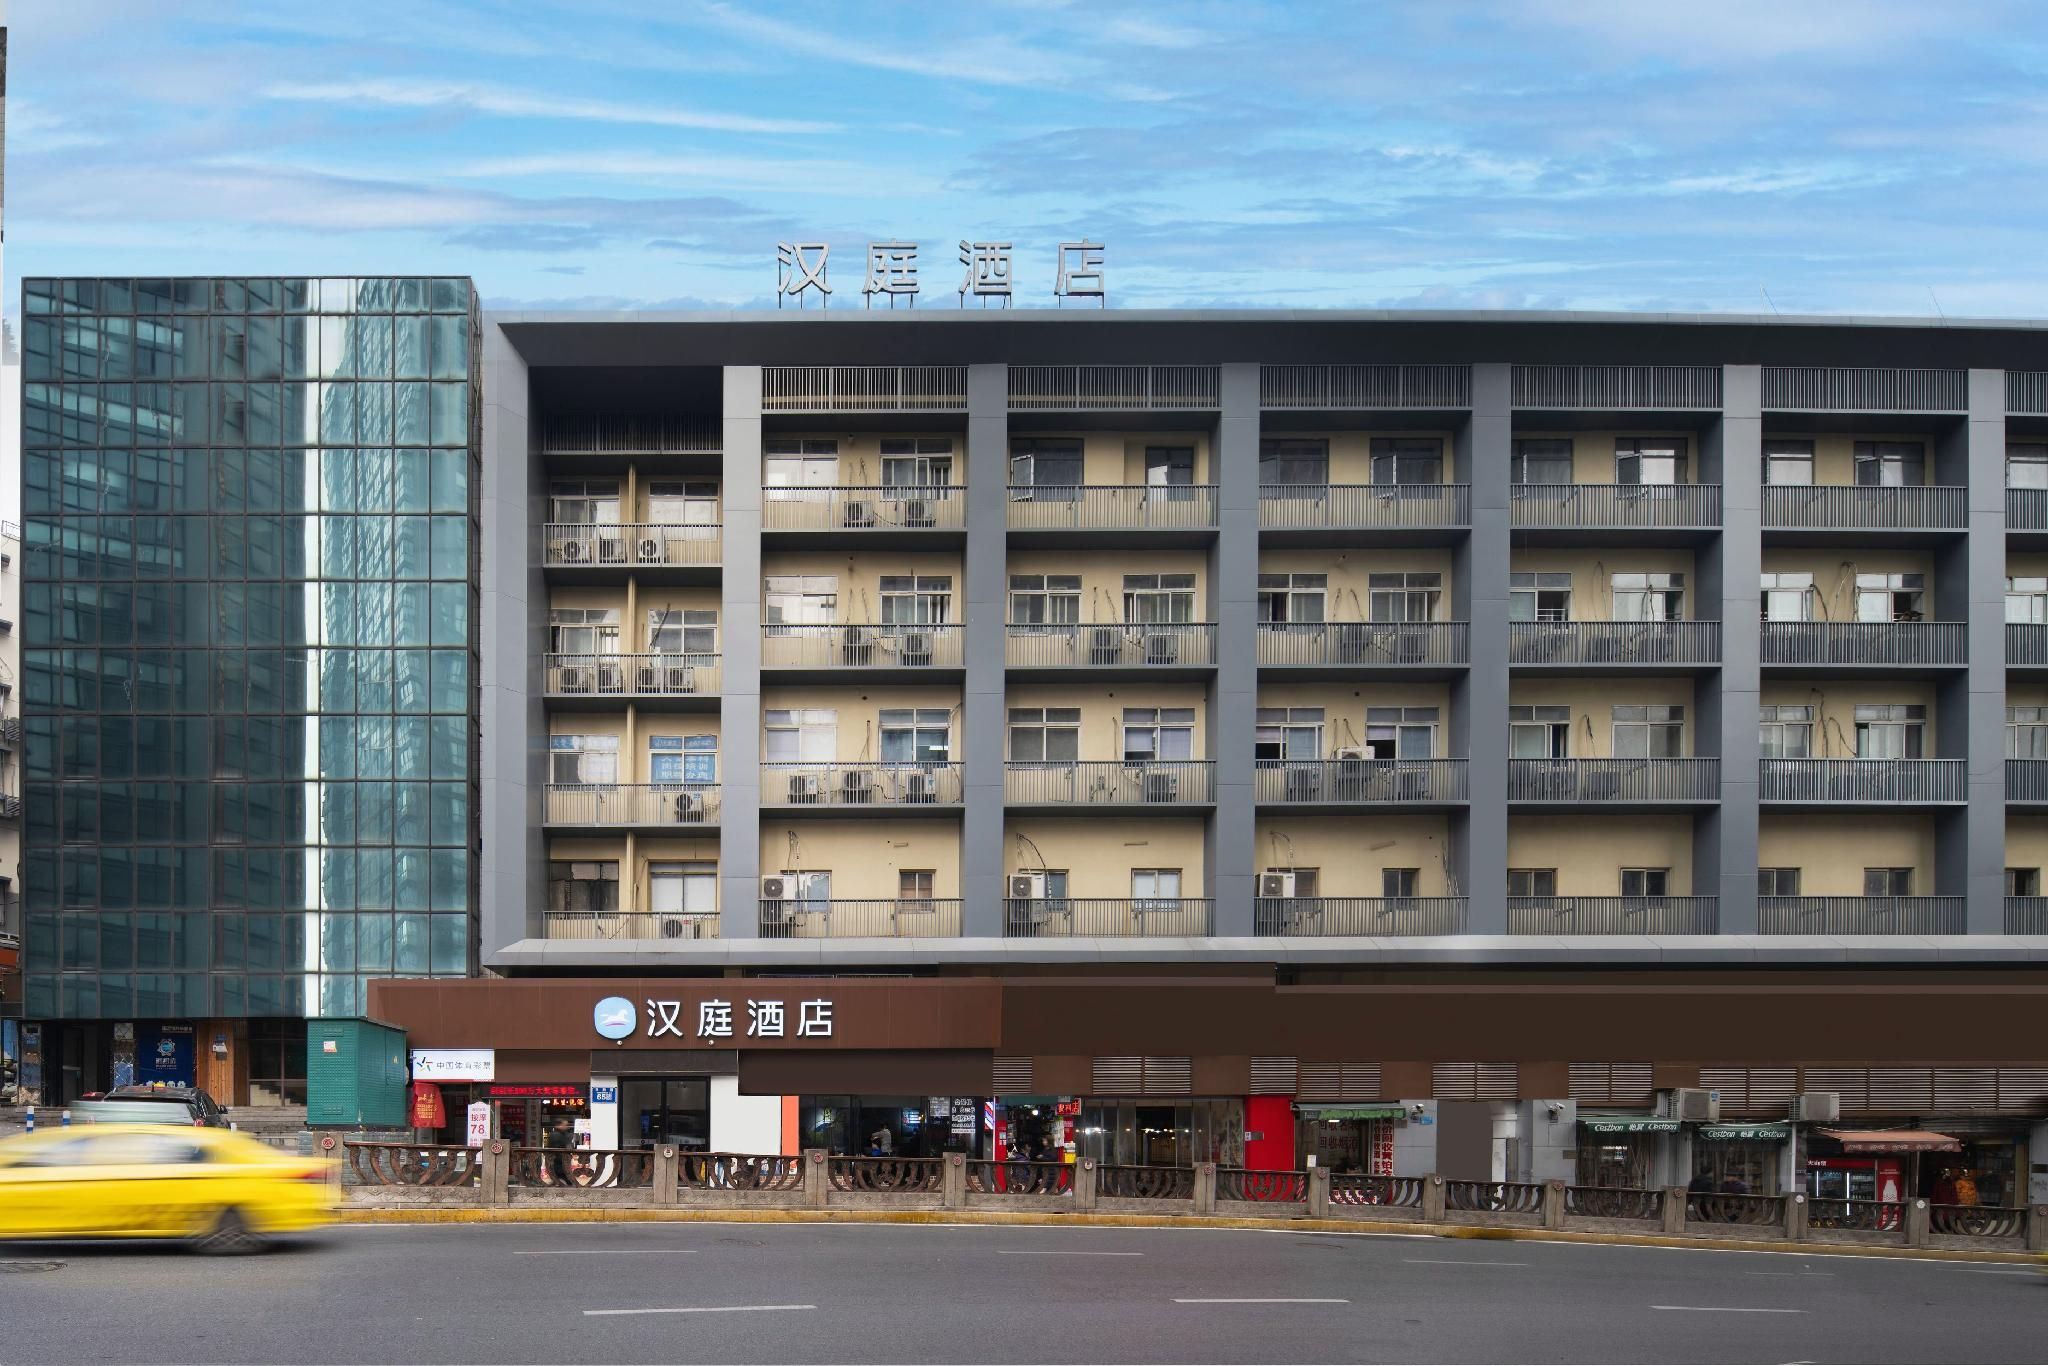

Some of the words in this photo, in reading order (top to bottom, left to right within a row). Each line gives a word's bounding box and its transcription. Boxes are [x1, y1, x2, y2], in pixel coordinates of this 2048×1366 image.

[776, 238, 1106, 296] 汉庭酒店
[646, 998, 834, 1038] 汉庭酒店
[470, 1124, 485, 1135] 78
